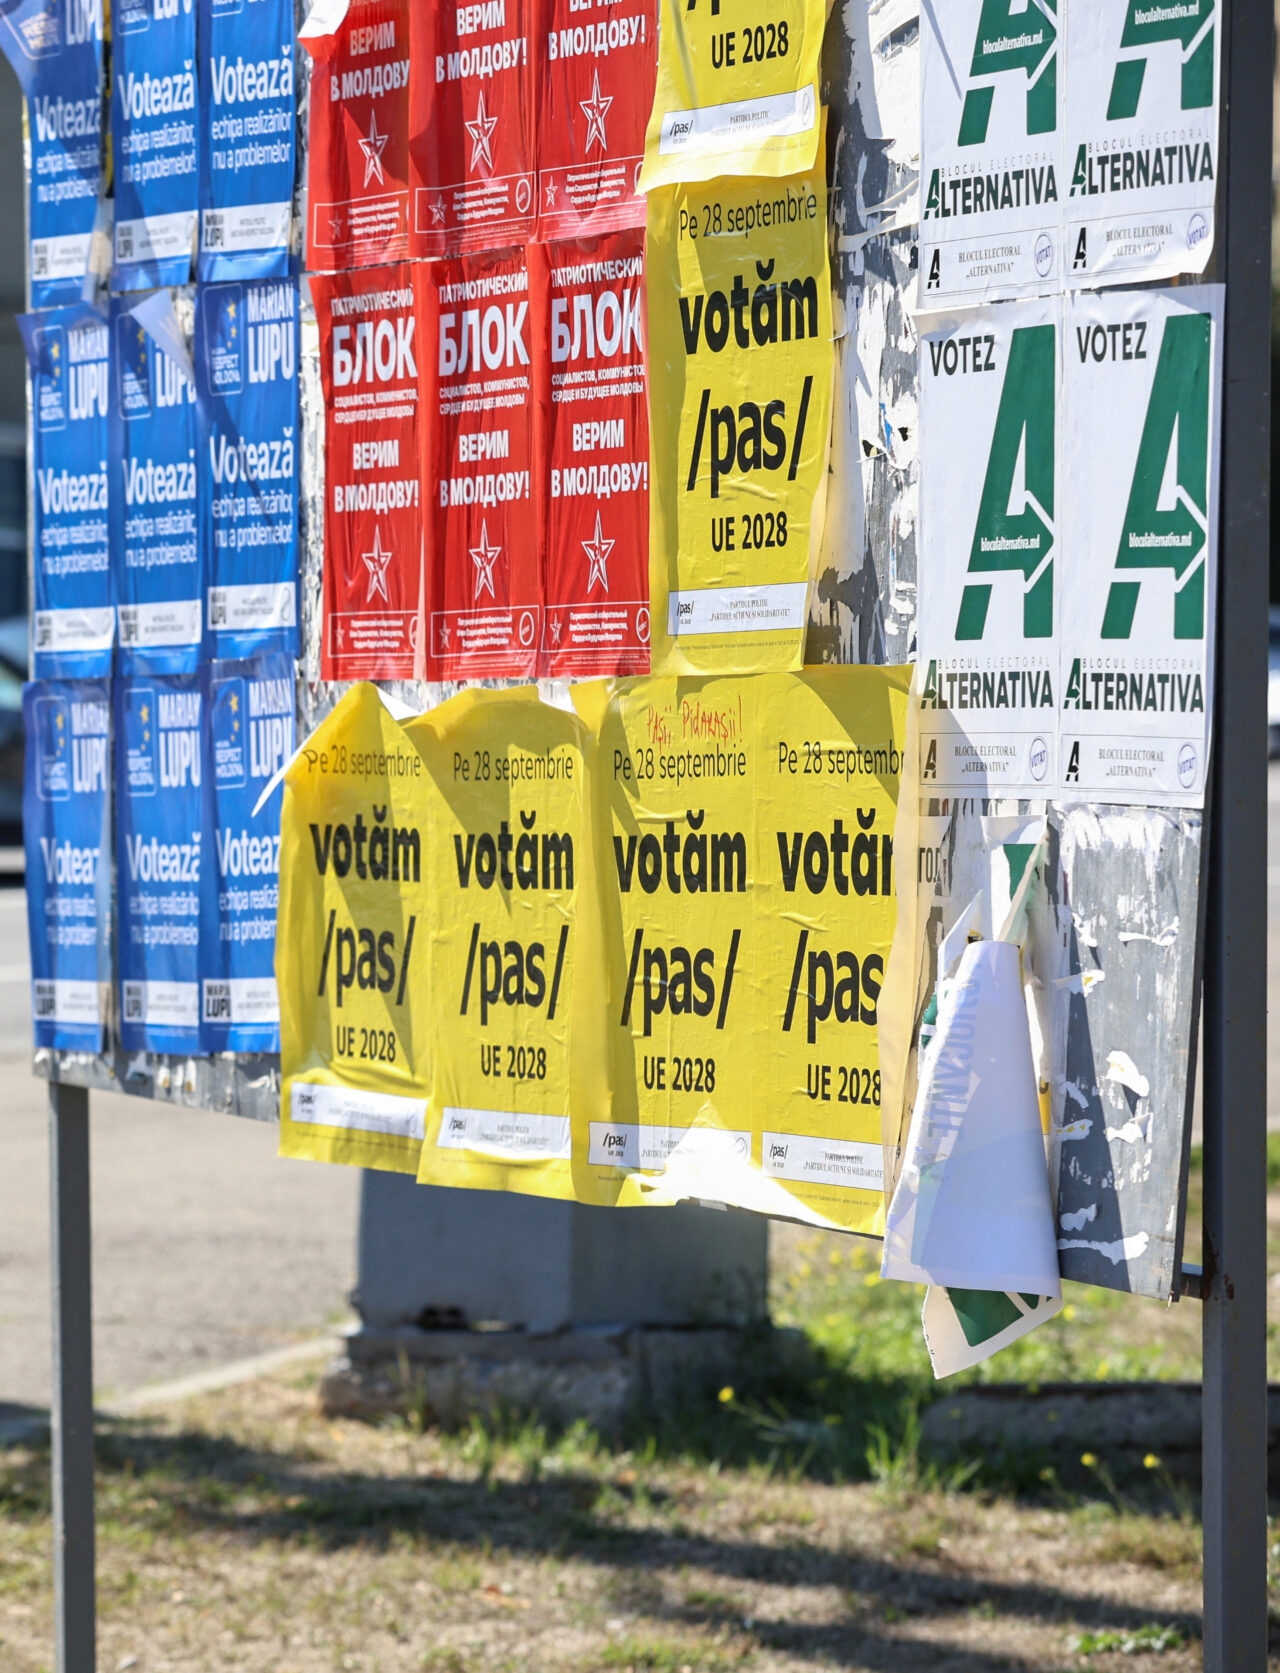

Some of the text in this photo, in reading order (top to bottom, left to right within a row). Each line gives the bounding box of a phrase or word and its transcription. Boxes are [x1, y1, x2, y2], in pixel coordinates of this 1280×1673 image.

[457, 1, 505, 36] ВЕРИМ
[1135, 1, 1199, 25] bloculalternativa.md
[350, 21, 395, 56] ВЕРИМ
[549, 15, 645, 60] В МОЛДОВУ!
[712, 21, 789, 69] UE 2028
[982, 30, 1043, 55] bloculalternativa.md
[210, 44, 293, 105] Votează
[436, 38, 527, 83] В МОЛДОВУ!
[118, 59, 194, 120] Votează
[331, 76, 340, 101] В
[212, 116, 243, 143] echipa
[670, 120, 693, 135] /pas/
[1088, 129, 1209, 153] BLOCUL ELECTORAL
[213, 152, 225, 170] nu
[227, 152, 233, 169] a
[942, 151, 1054, 177] BLOCUL ELECTORAL
[1070, 142, 1214, 197] ALTERNATIVA
[924, 165, 1058, 220] ALTERNATIVA
[680, 209, 698, 240] Pe
[703, 202, 722, 236] 28
[728, 186, 817, 238] septembrie
[1073, 227, 1086, 269] A
[1106, 224, 1173, 241] BLOCUL ELECTORAL
[928, 249, 940, 289] A
[959, 245, 1022, 263] BLOCUL ELECTORAL
[247, 283, 294, 323] MARIAN
[331, 283, 414, 317] ПАТРИОТИЧЕСКИЙ
[439, 267, 528, 304] ПАТРИОТИЧЕСКИЙ
[551, 287, 643, 363] БЛОК
[678, 259, 819, 355] votăm
[247, 321, 294, 383] LUPU
[332, 316, 417, 386] БЛОК
[439, 301, 530, 377] БЛОК
[930, 335, 995, 376] VOTEZ
[1077, 322, 1147, 363] VOTEZ
[69, 362, 108, 420] LUPU
[440, 376, 529, 399] СОЦИАЛИСТОВ, КОММУНИСТОВ,
[552, 371, 597, 387] СОЦИАЛИСТОВ,
[552, 389, 573, 403] СЕРДЦЕ
[610, 381, 643, 397] МОЛДОВЫ
[495, 393, 524, 409] МОЛДОВЫ
[459, 430, 509, 463] ВЕРИМ
[573, 419, 624, 452] ВЕРИМ
[687, 376, 813, 498] /pas/
[210, 427, 293, 484] Votează
[353, 440, 399, 470] ВЕРИМ
[37, 460, 108, 514] Votează
[440, 470, 530, 508] В МОЛДОВУ!
[551, 462, 648, 499] В МОЛДОВУ!
[955, 324, 1055, 640] A
[1101, 312, 1212, 639] A
[212, 496, 245, 522] echipa
[335, 479, 419, 515] В МОЛДОВУ!
[215, 529, 235, 547] nu a
[711, 512, 788, 552] UE 2028
[981, 534, 1040, 552] bloculalternativa.md
[1129, 532, 1192, 547] bloculalternativa.md
[126, 550, 138, 567] nu
[677, 601, 694, 617] /pas/
[939, 657, 1050, 669] BLOCUL ELECTORAL
[1083, 658, 1201, 670] BLOCUL ELECTORAL
[249, 678, 293, 717] MARIAN
[921, 659, 1054, 709] ALTERNATIVA
[1064, 658, 1204, 713] ALTERNATIVA
[159, 730, 201, 787] LUPU
[302, 745, 420, 782] Pe 28 septembrie
[454, 747, 573, 788] Pe 28 septembrie
[614, 744, 746, 786] Pe 28 septembrie
[779, 742, 797, 774] Pe
[804, 741, 822, 774] 28
[924, 739, 936, 778] A
[955, 746, 1016, 756] BLOCUL ELECTORAL
[1066, 741, 1079, 782] A
[1098, 749, 1164, 762] BLOCUL ELECTORAL
[309, 805, 421, 882] votăm
[453, 810, 574, 890] votăm
[613, 809, 746, 894] votăm
[220, 922, 232, 941] nu
[318, 909, 416, 1008] /pas/
[460, 923, 569, 1026] /pas/
[620, 929, 741, 1036] /pas/
[337, 1026, 396, 1063] UE 2028
[481, 1044, 546, 1080] UE 2028
[644, 1056, 715, 1092] UE 2028
[807, 1064, 881, 1106] UE 2028
[603, 1133, 627, 1148] /pas/
[770, 1144, 788, 1159] /pas/
